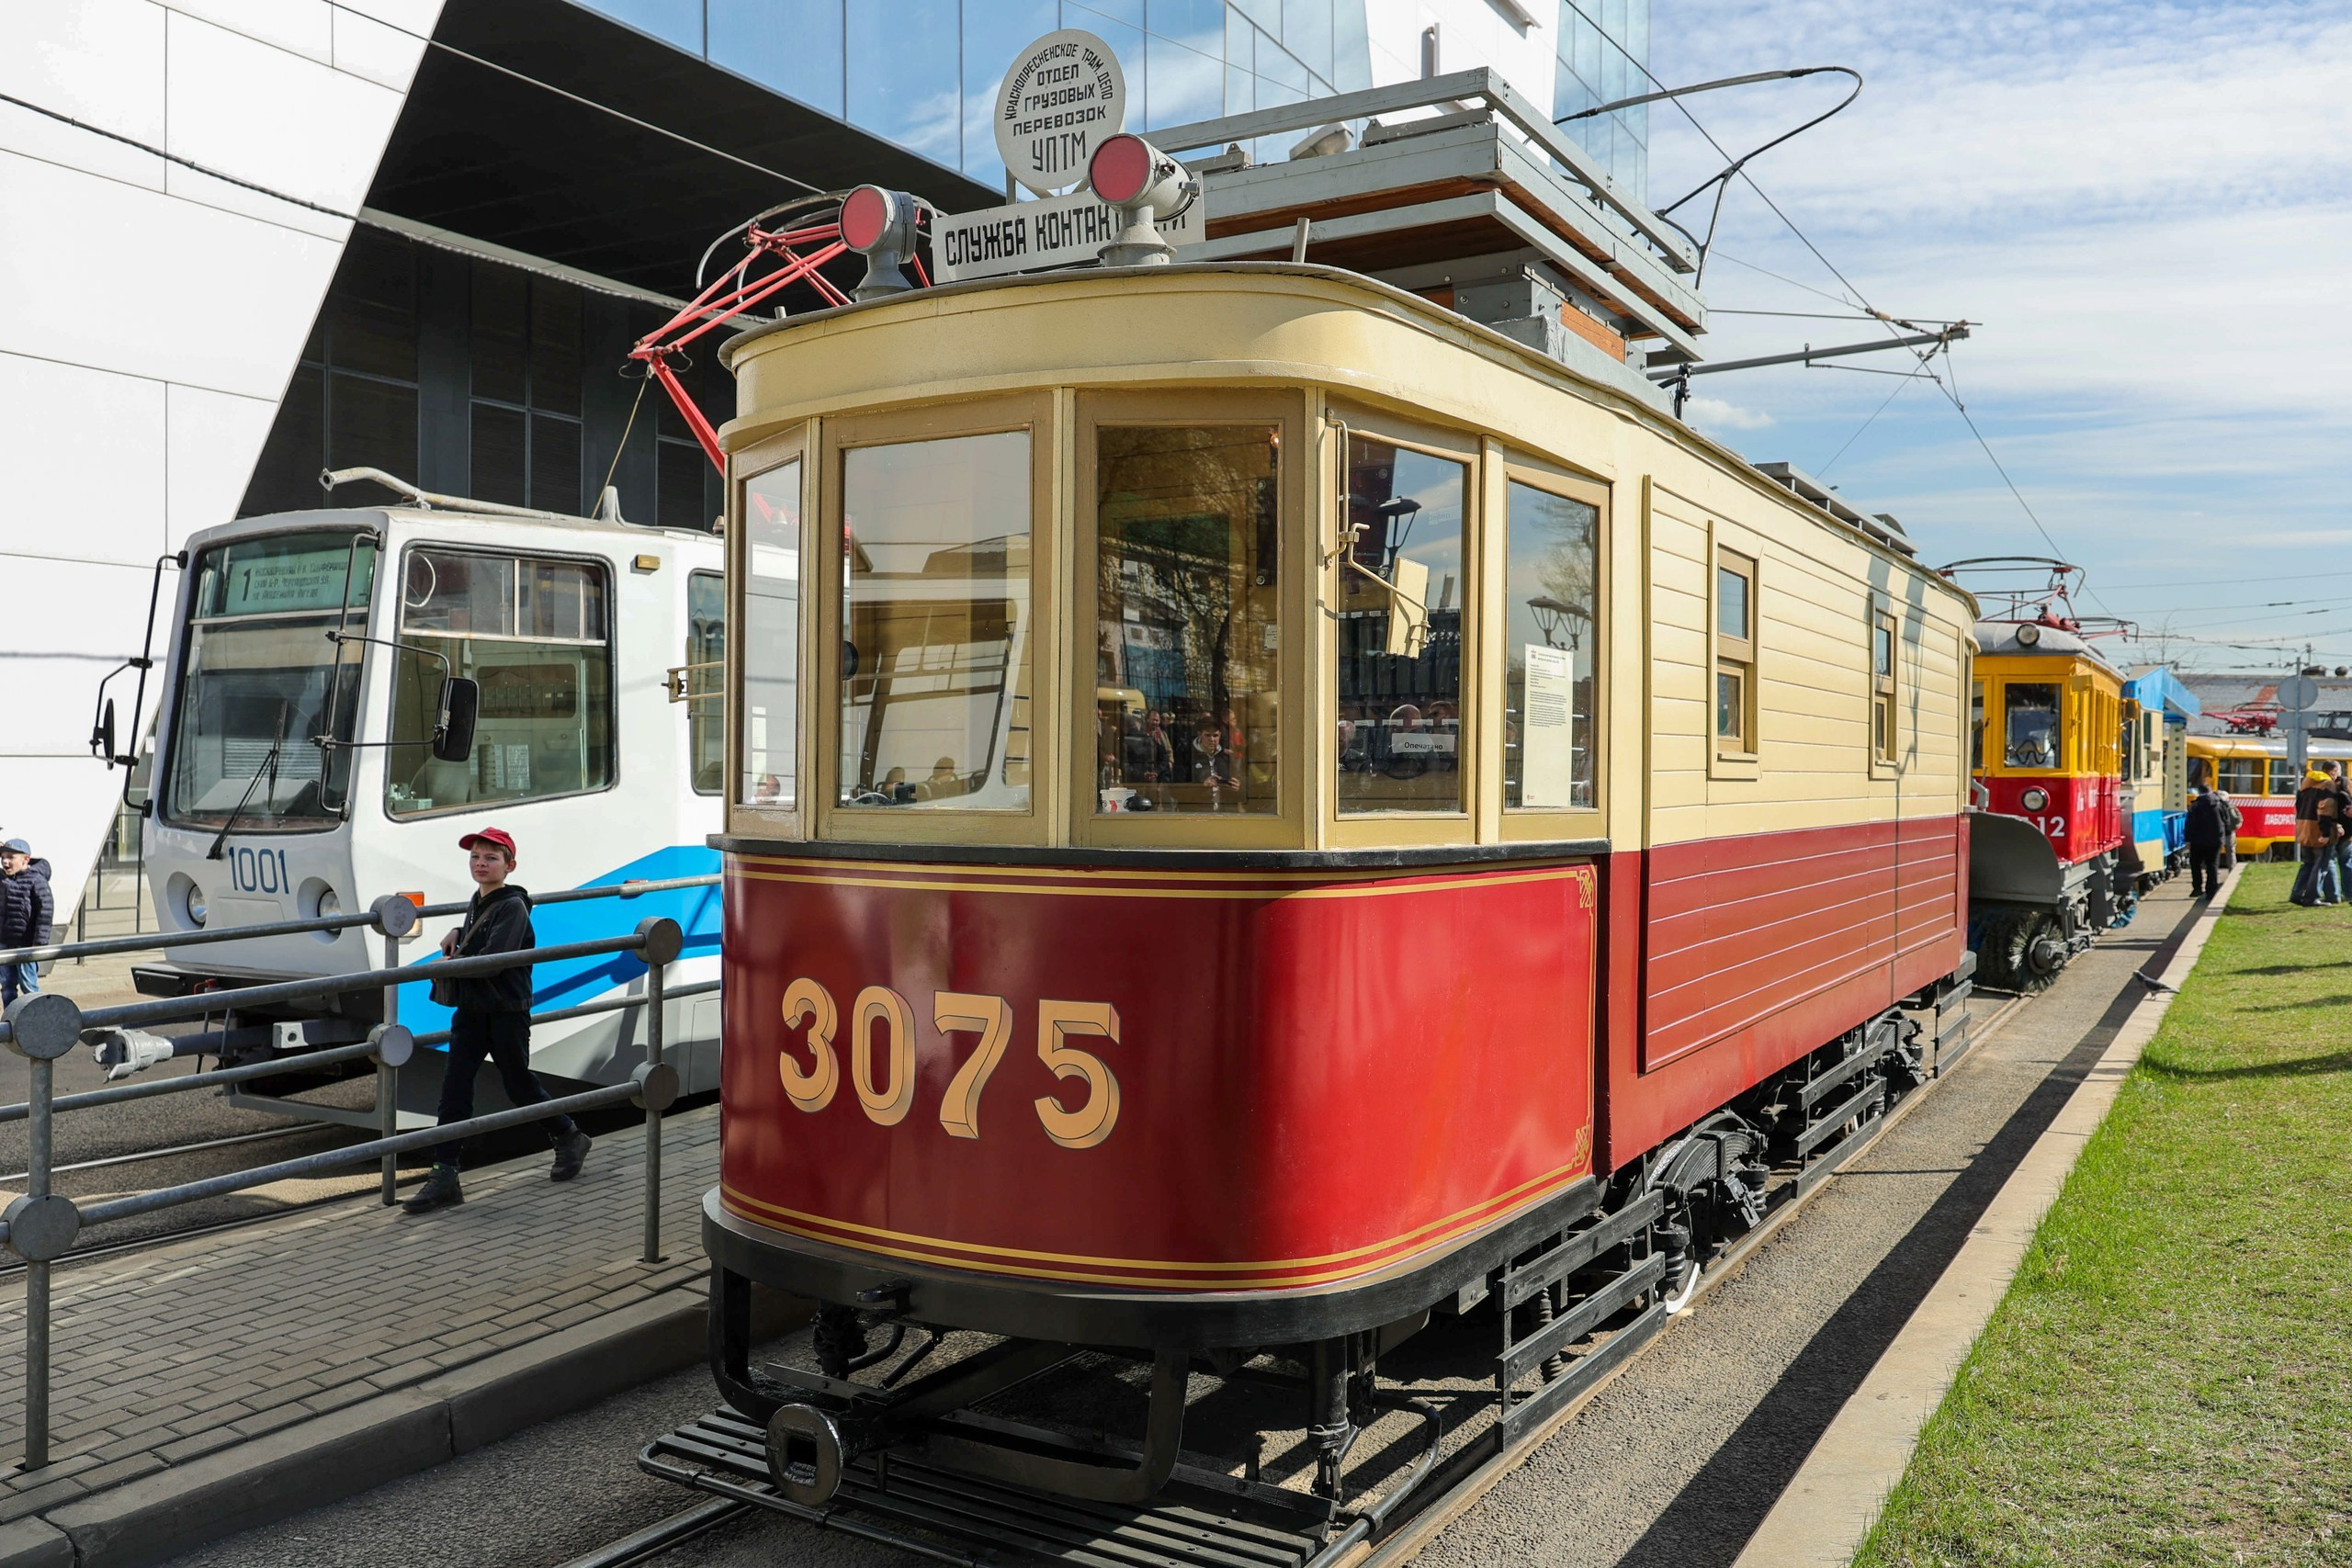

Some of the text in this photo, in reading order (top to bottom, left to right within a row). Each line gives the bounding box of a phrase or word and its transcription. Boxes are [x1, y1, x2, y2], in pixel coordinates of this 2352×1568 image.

[1004, 43, 1114, 120] КРАСНОПРЕСНЕНСКОЕ ТРАМ. ДЕПО
[1036, 63, 1080, 86] ОТДЕЛ
[1024, 83, 1096, 112] ГРУЗОВЫХ
[1013, 105, 1107, 137] ПЕРЕВОЗОК
[1032, 130, 1087, 173] УПТМ
[945, 218, 1027, 266] СЛУЖБА
[242, 568, 252, 602] 1
[228, 846, 289, 895] 1001
[778, 977, 1121, 1150] 3075
